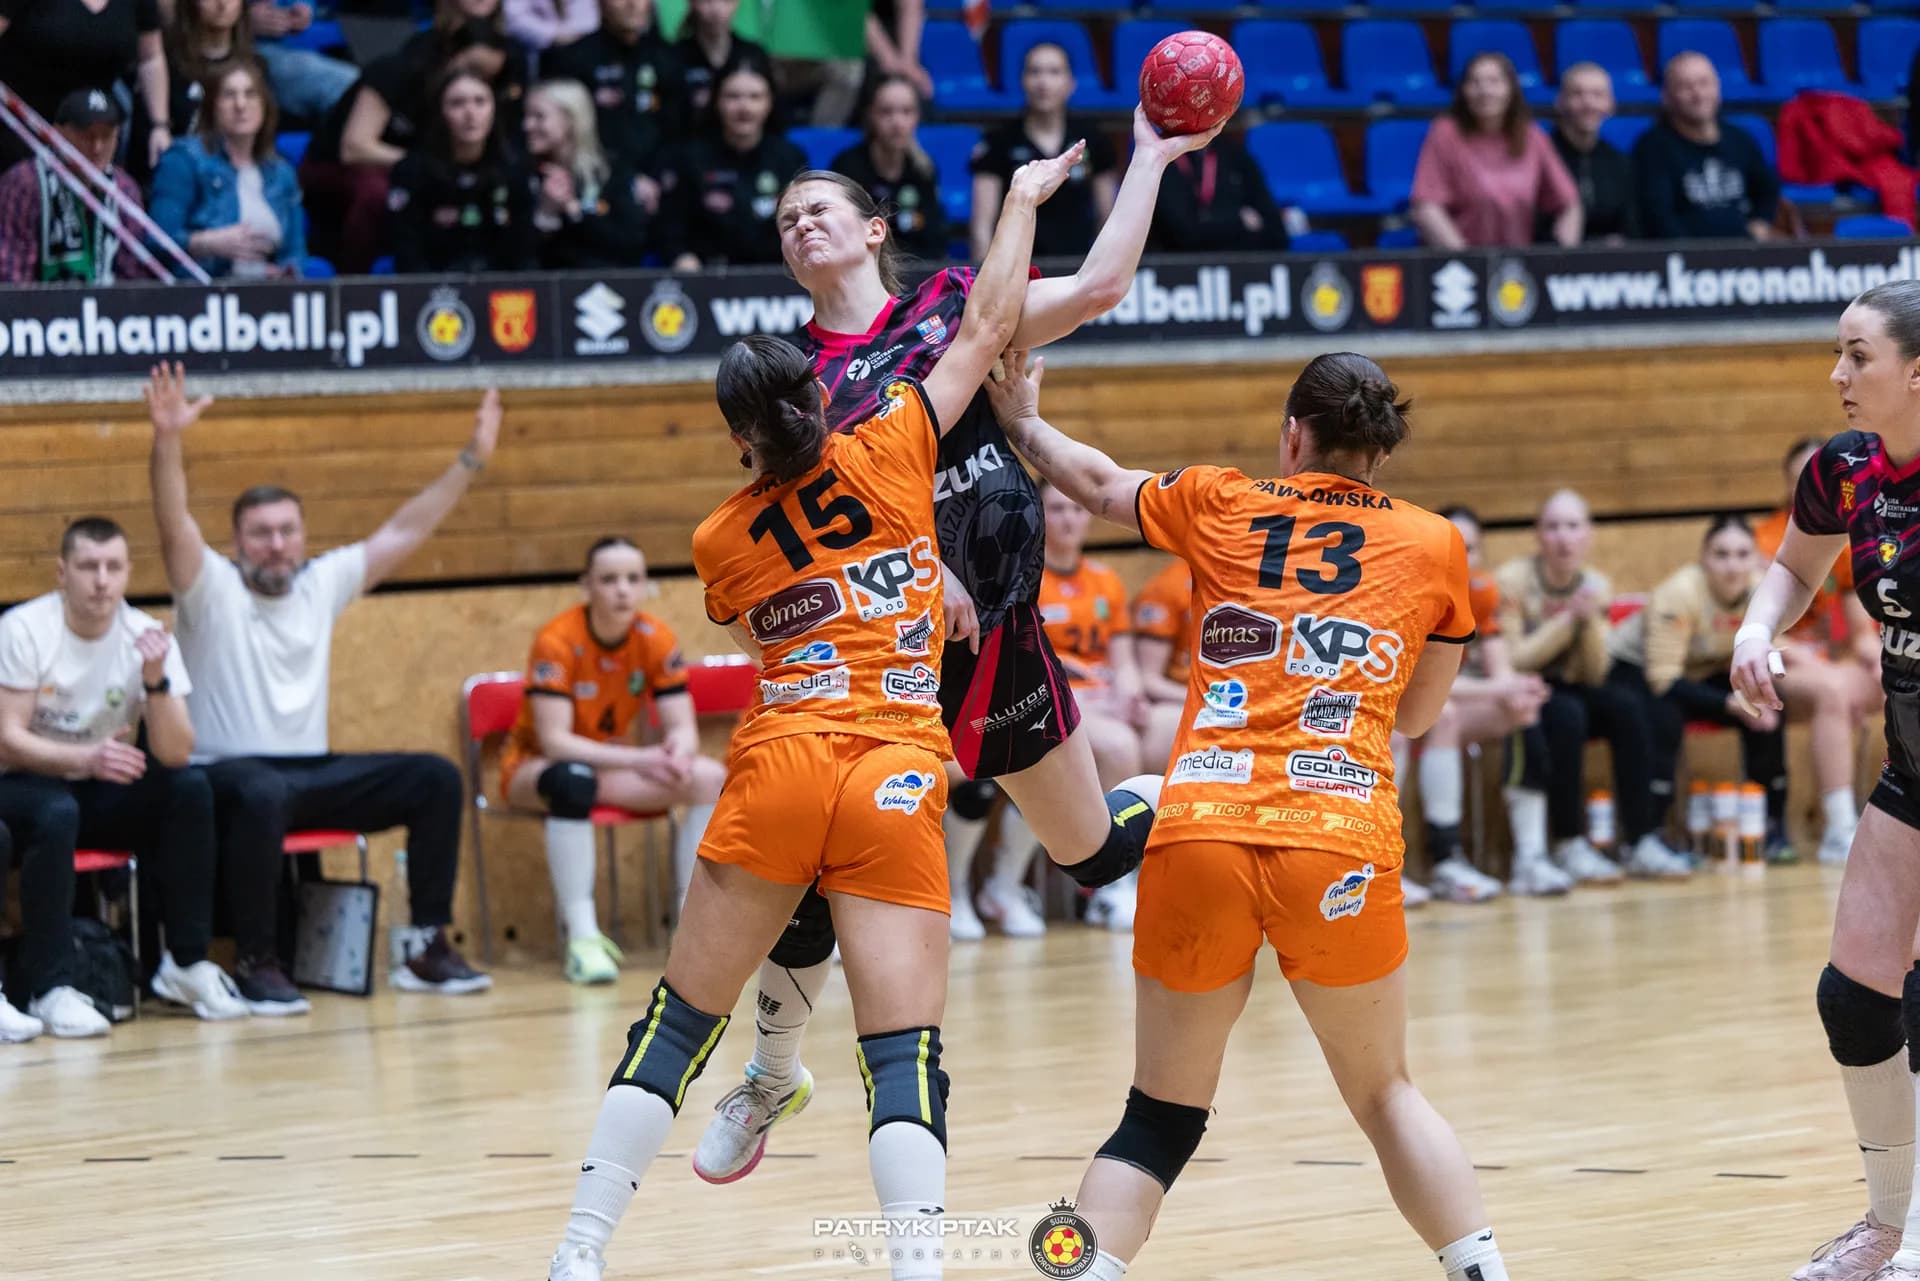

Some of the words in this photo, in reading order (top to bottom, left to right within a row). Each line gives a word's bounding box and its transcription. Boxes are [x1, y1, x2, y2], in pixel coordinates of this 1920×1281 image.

[1546, 248, 1920, 312] www.koronahand
[1086, 264, 1290, 336] dball.pl
[0, 289, 399, 367] nahandball.pl
[748, 468, 873, 572] 15
[846, 538, 940, 600] KPS
[1248, 514, 1366, 595] 13
[761, 593, 824, 631] elmas
[863, 600, 905, 617] FOOD
[1876, 578, 1912, 618] 5
[1204, 620, 1260, 645] elmas
[1296, 616, 1401, 679] KPS
[1880, 622, 1920, 660] UZ
[1290, 663, 1338, 677] FOOD
[983, 684, 1047, 726] ALUTOR
[1305, 705, 1352, 718] AKADEMIA
[1295, 779, 1367, 798] SECURITY
[1297, 760, 1369, 781] GOLIAT
[1212, 804, 1246, 816] TICO
[1277, 809, 1310, 822] TICO
[1343, 817, 1373, 832] TICO
